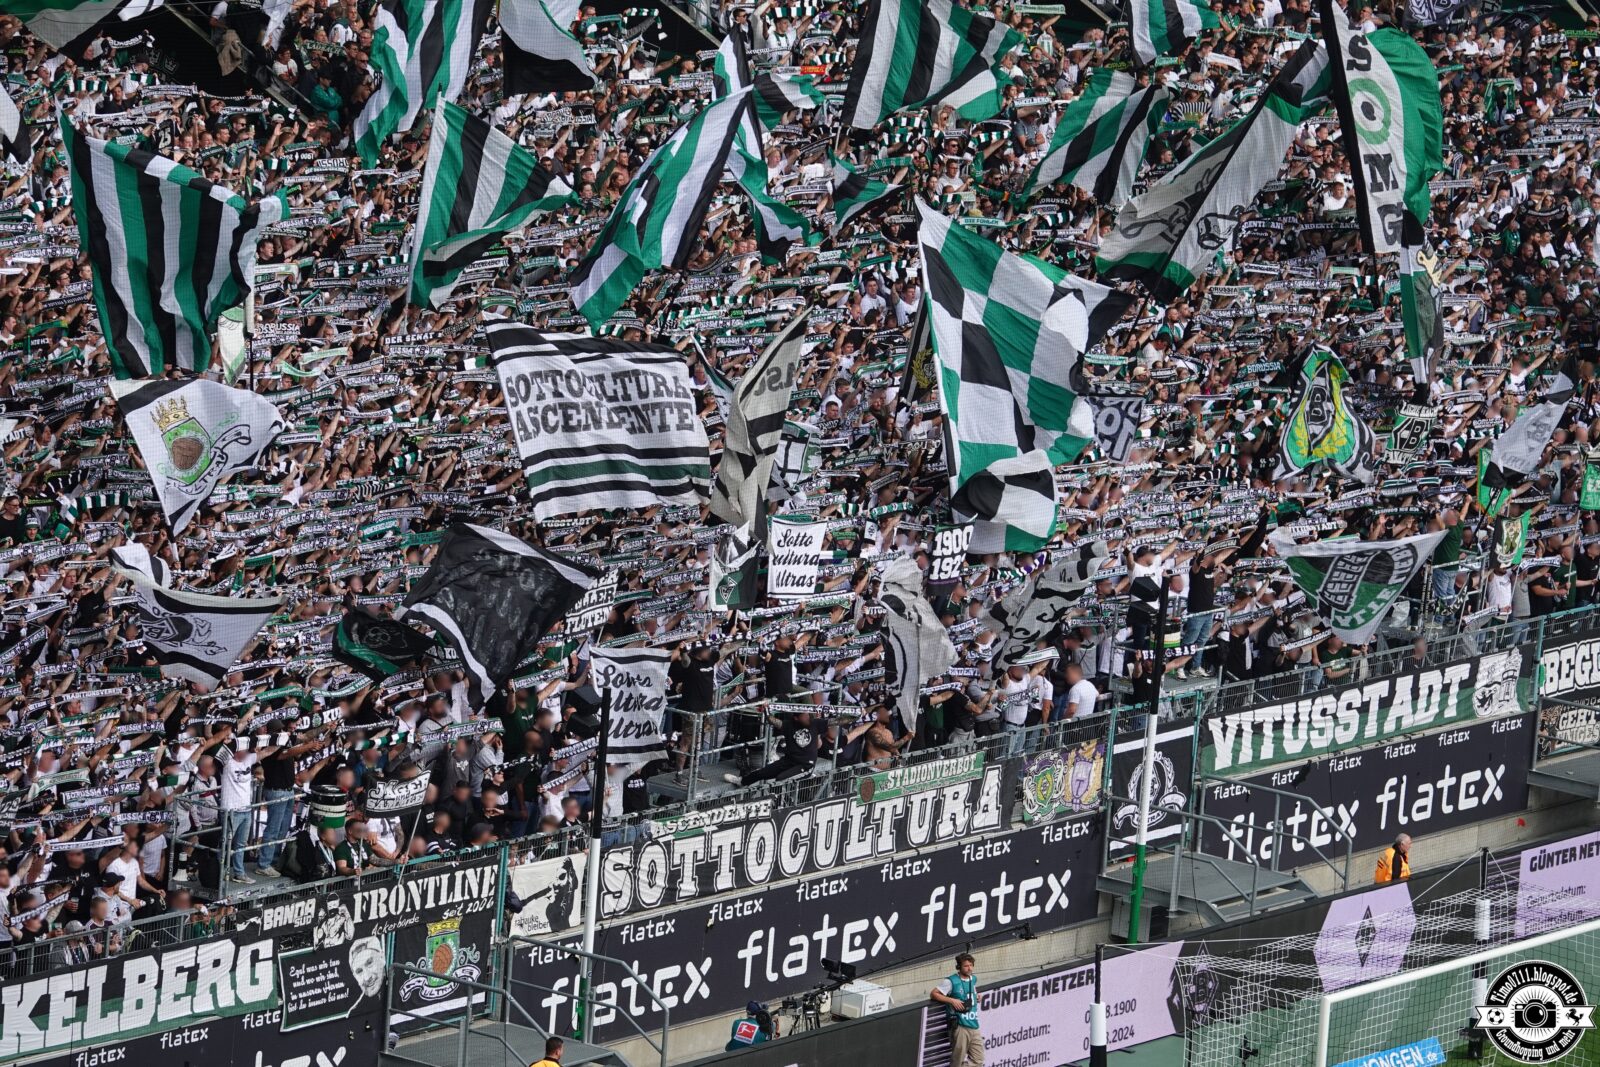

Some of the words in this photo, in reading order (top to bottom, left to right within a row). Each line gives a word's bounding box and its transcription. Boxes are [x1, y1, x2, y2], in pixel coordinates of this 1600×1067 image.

[776, 528, 814, 549] Sotto
[934, 524, 974, 557] 1900
[1208, 663, 1471, 771] VITUSSTADT
[1491, 718, 1523, 734] flatex
[1384, 742, 1417, 760] flatex
[1438, 730, 1470, 747] flatex
[887, 756, 977, 789] STADIONVERBOT
[1328, 755, 1362, 773] flatex
[1375, 763, 1506, 830] flatex
[600, 765, 1001, 918] SOTTOCULTURA
[1041, 821, 1090, 844] flatex
[962, 840, 1011, 863] flatex
[1529, 849, 1577, 873] GÜNTER
[881, 858, 932, 882] flatex
[353, 865, 498, 924] FRONTLINE
[796, 877, 849, 902] flatex
[263, 898, 316, 930] BANDA
[442, 906, 464, 920] seit
[709, 898, 764, 925] flatex
[921, 869, 1072, 943] flatex
[620, 919, 676, 944] flatex
[737, 911, 899, 989] flatex
[980, 982, 1041, 1012] GÜNTER
[1041, 967, 1096, 997] NETZER
[160, 1029, 209, 1049] flatex
